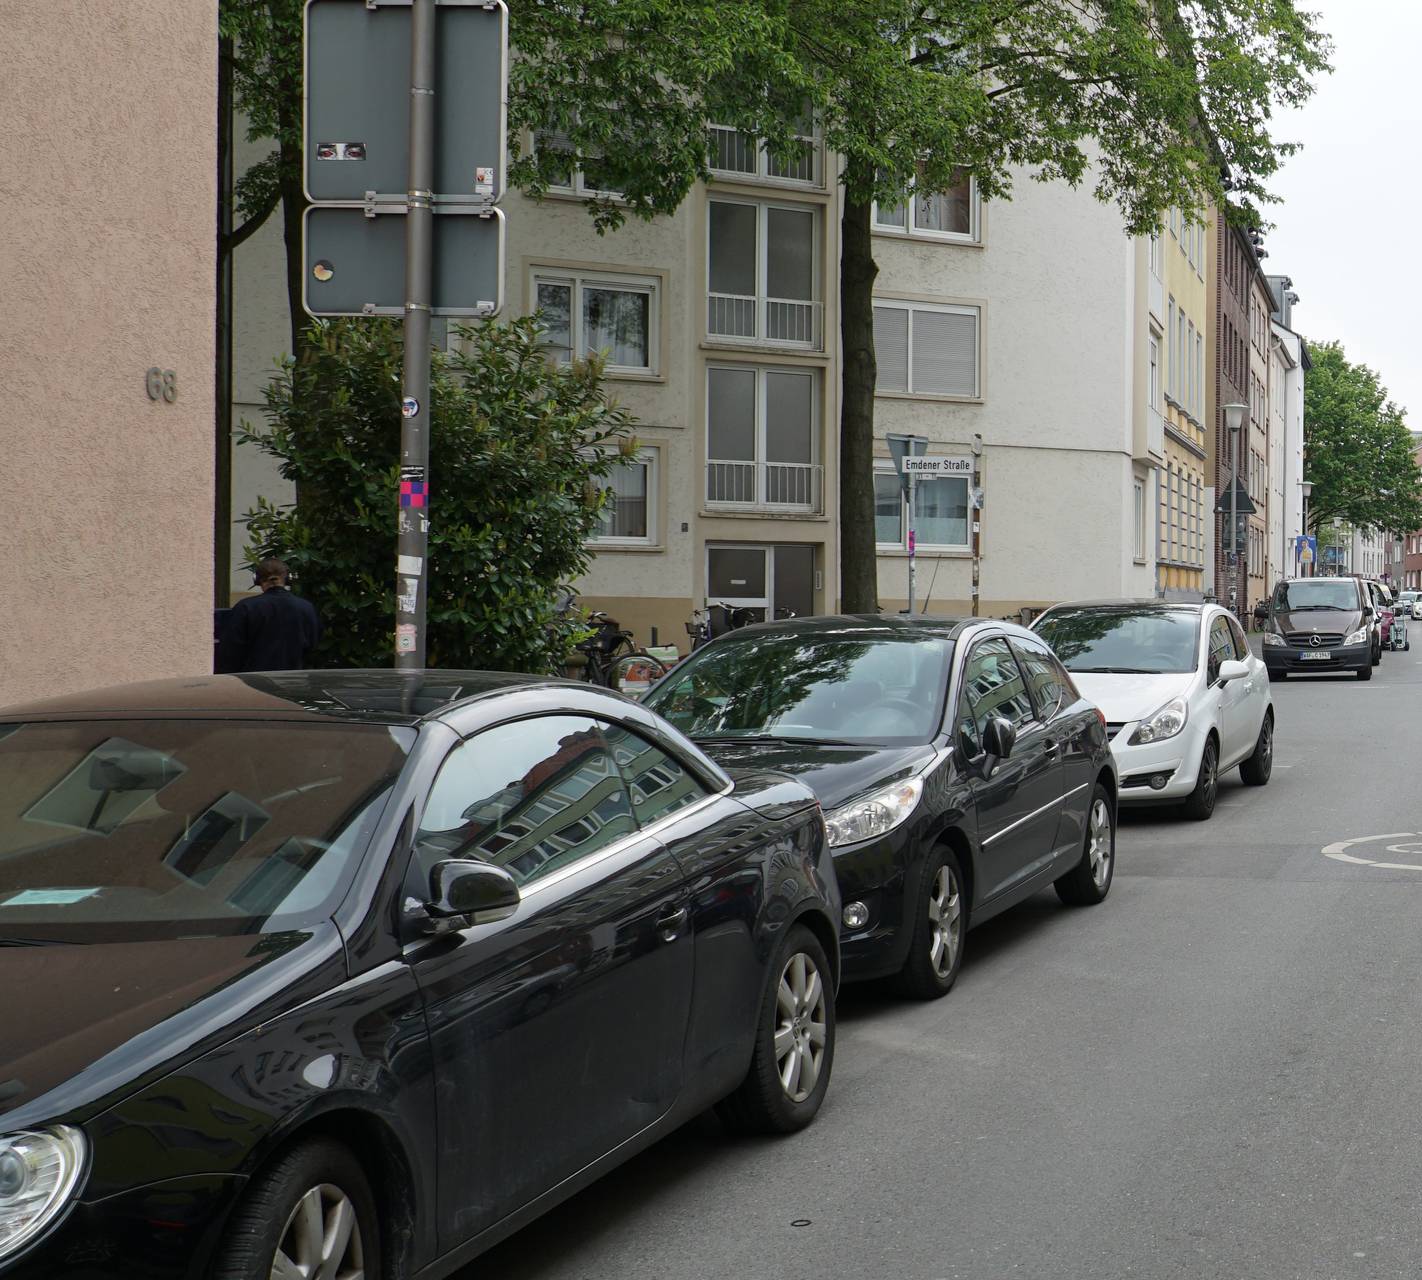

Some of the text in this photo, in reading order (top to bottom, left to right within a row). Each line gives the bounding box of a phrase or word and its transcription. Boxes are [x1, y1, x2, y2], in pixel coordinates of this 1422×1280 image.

[146, 367, 177, 403] 68
[905, 459, 970, 470] Emdener Straße
